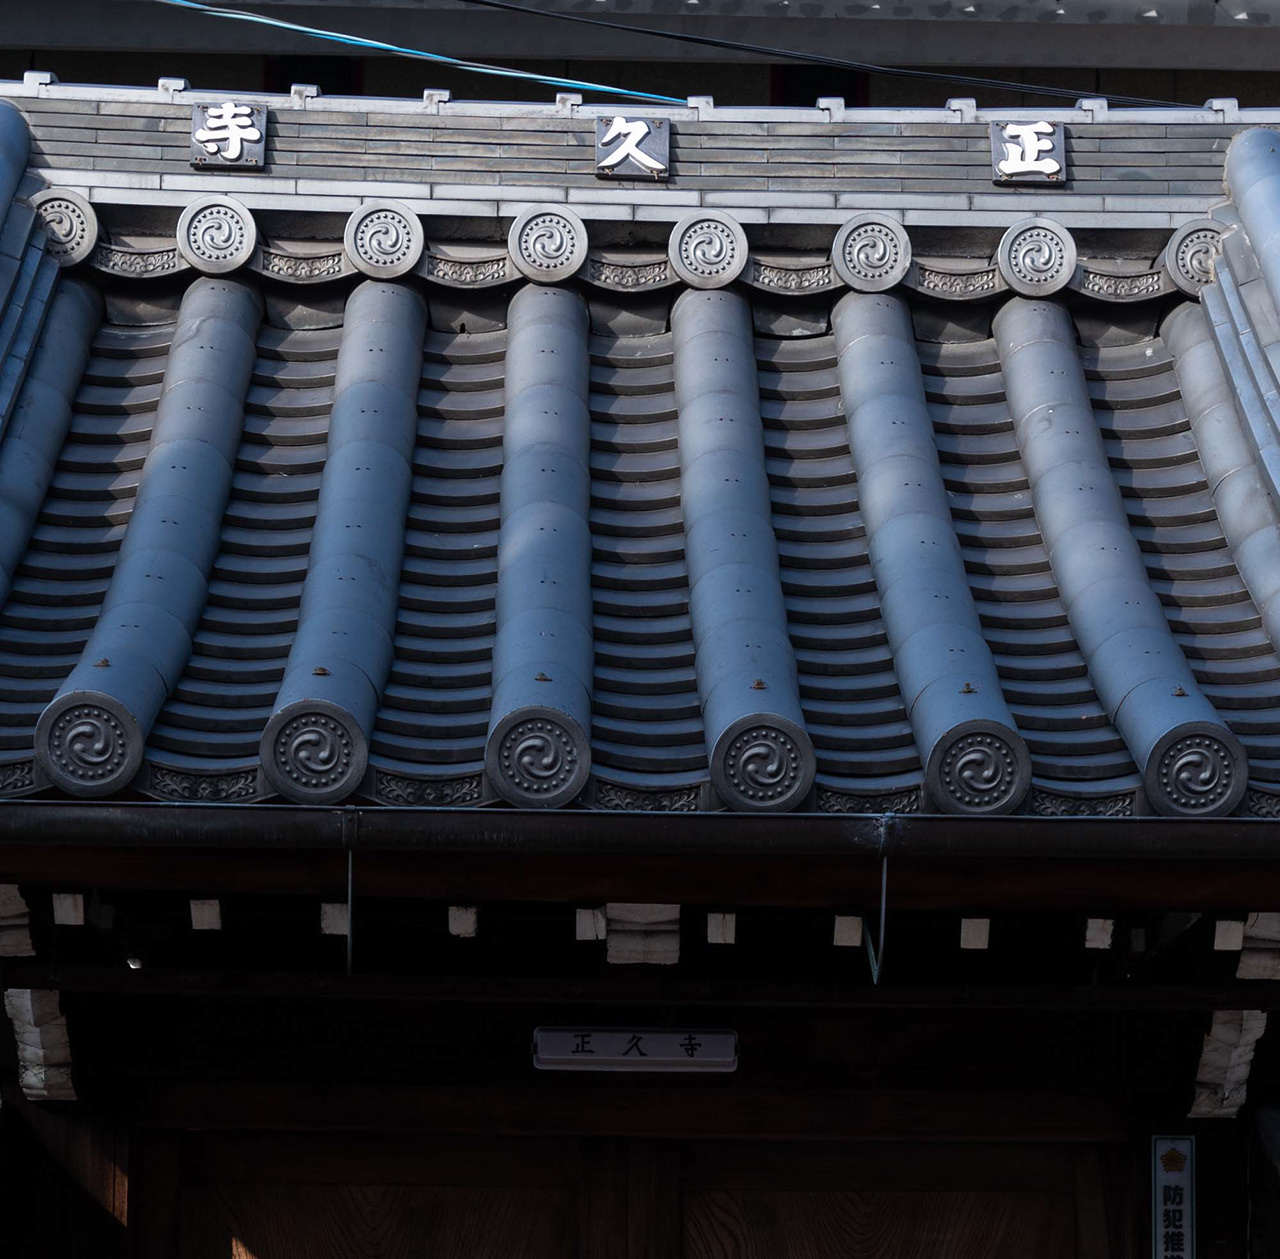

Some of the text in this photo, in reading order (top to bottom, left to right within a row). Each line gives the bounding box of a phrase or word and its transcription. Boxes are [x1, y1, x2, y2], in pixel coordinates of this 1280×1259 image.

[194, 102, 1062, 180] 正 久 寺
[571, 1033, 702, 1058] 正久寺
